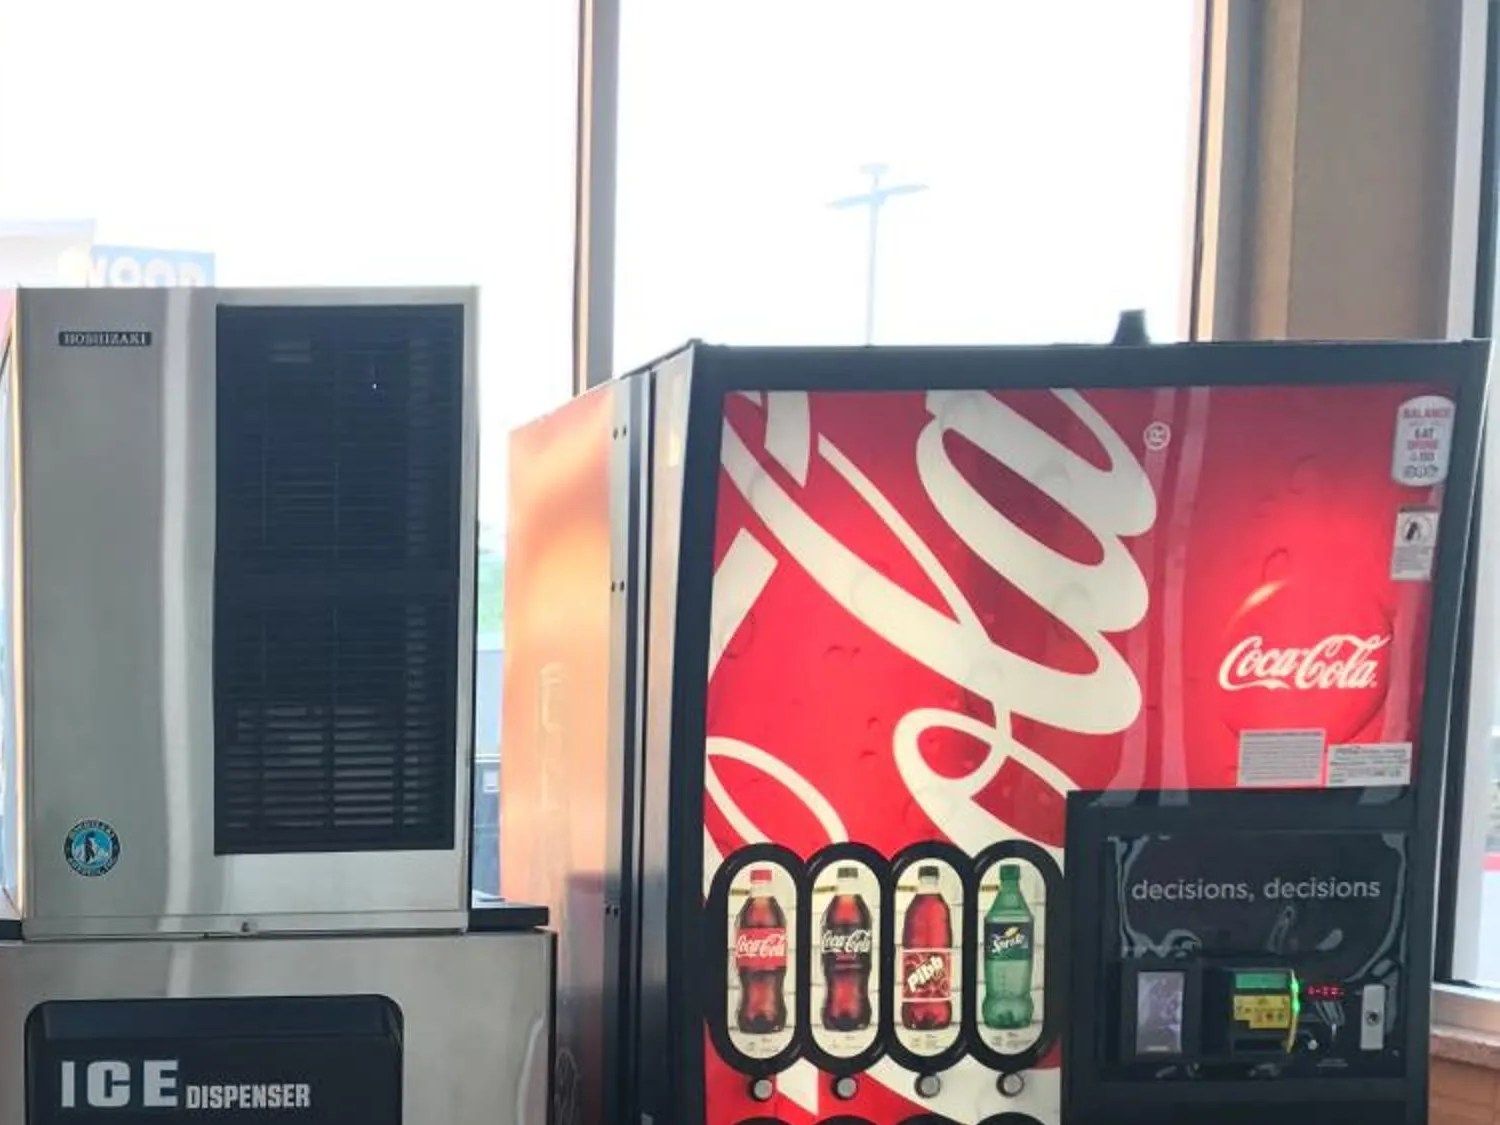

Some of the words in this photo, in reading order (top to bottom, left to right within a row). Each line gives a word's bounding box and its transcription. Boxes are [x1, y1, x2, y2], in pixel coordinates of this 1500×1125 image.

[63, 331, 146, 346] HOSHIZAKI
[1219, 634, 1392, 690] Coca-Cola
[1131, 878, 1255, 902] decisions,
[1263, 877, 1381, 899] decisions
[737, 934, 786, 958] Coca-Cola
[61, 1060, 179, 1107] ICE
[186, 1083, 311, 1110] DISPENSER
